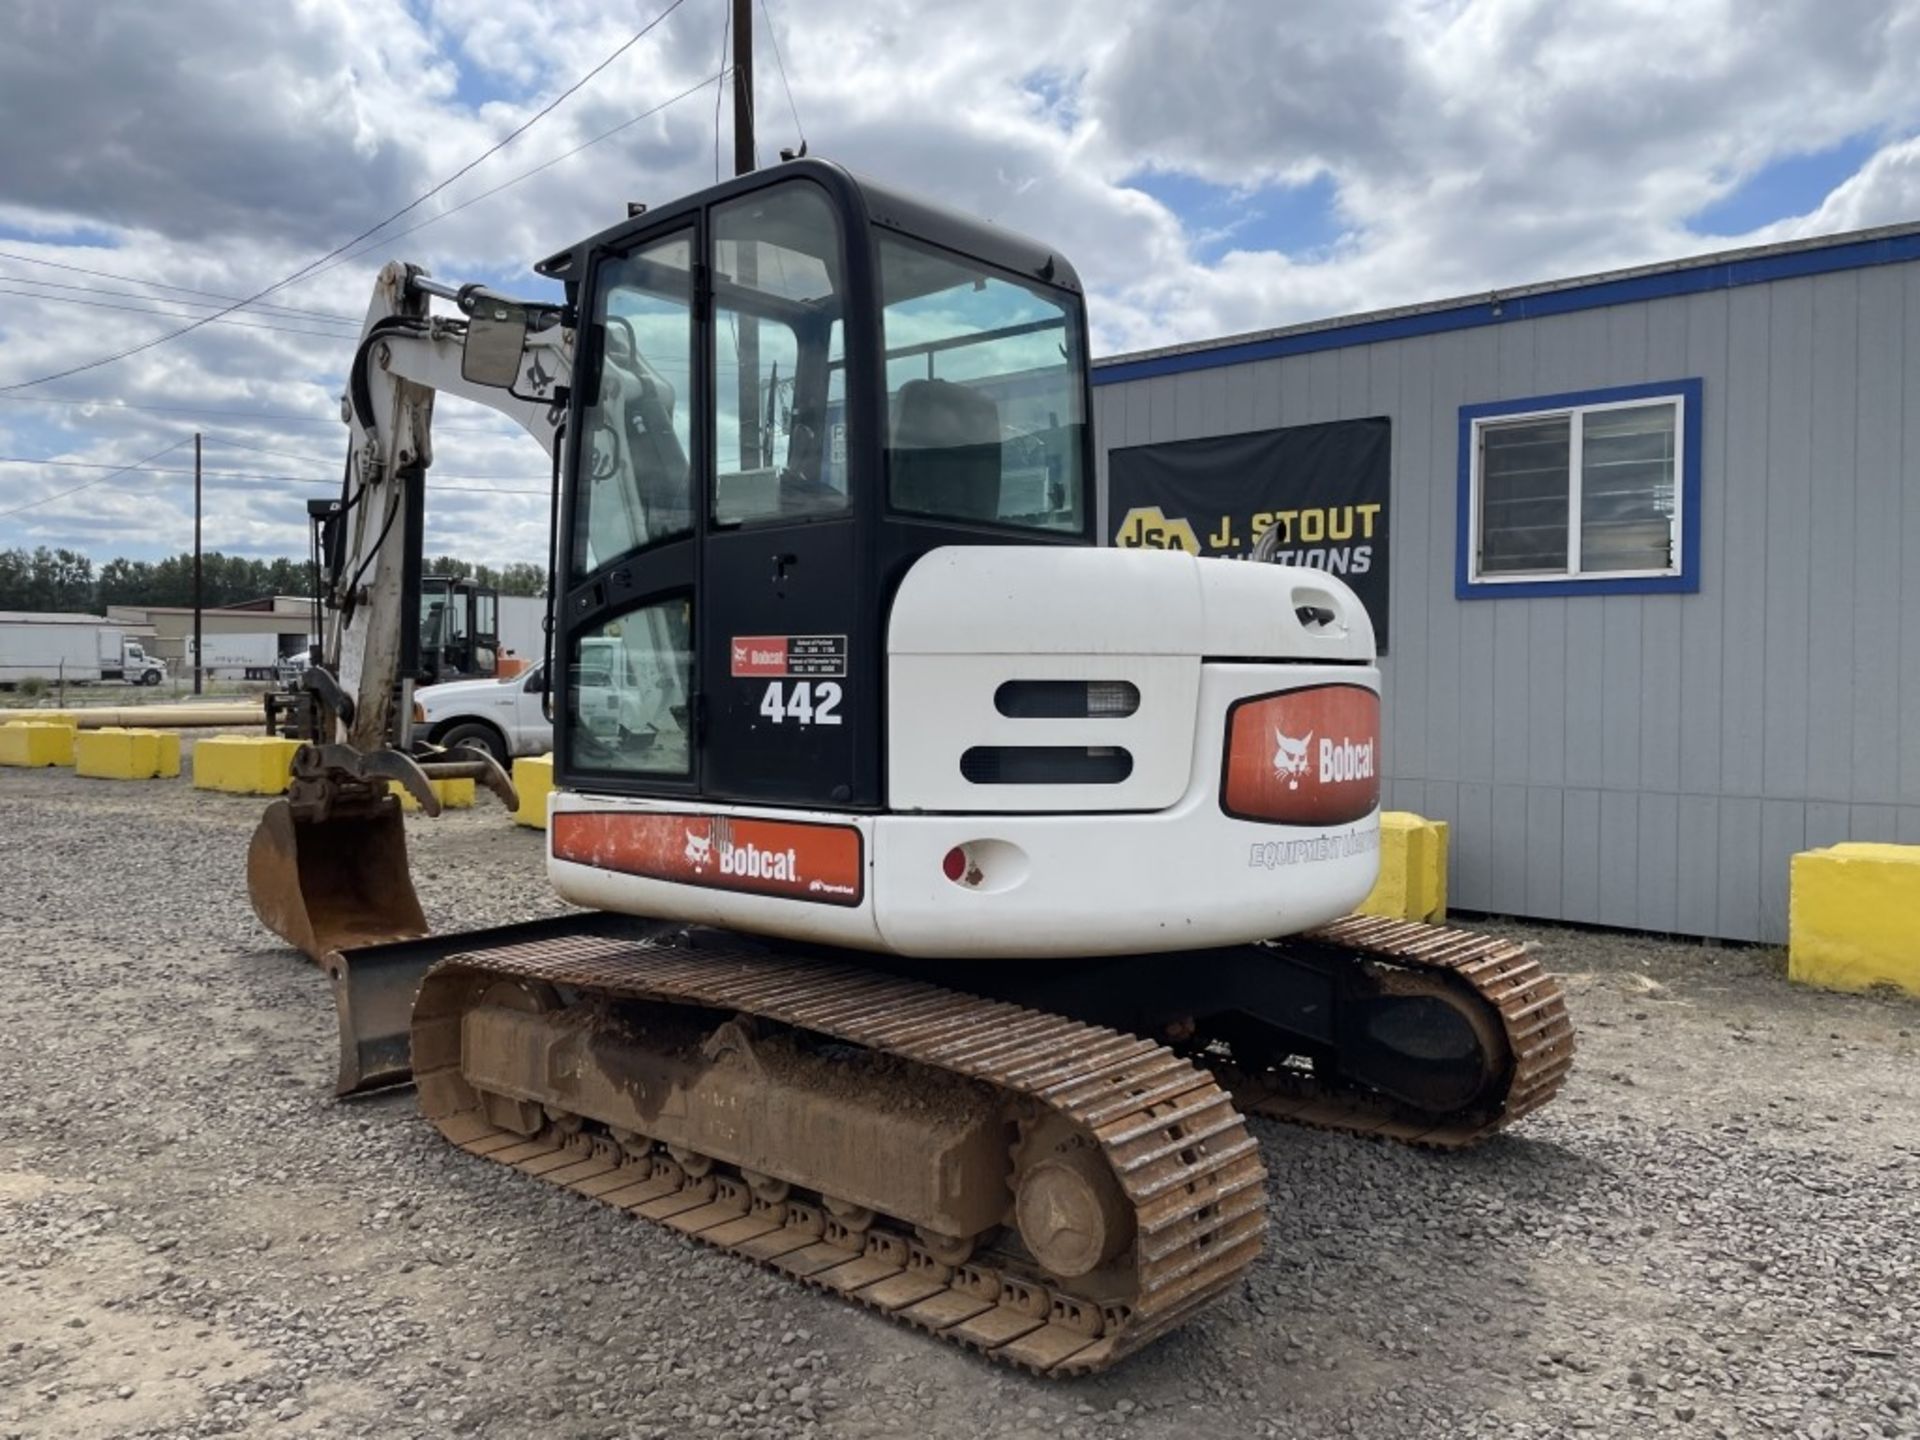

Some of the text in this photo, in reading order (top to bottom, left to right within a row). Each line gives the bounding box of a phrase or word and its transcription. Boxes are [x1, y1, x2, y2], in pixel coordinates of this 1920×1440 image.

[1209, 504, 1381, 547] J. STOUT
[760, 681, 843, 725] 442
[1319, 737, 1374, 784] Bobcat
[719, 841, 796, 882] Bobcat
